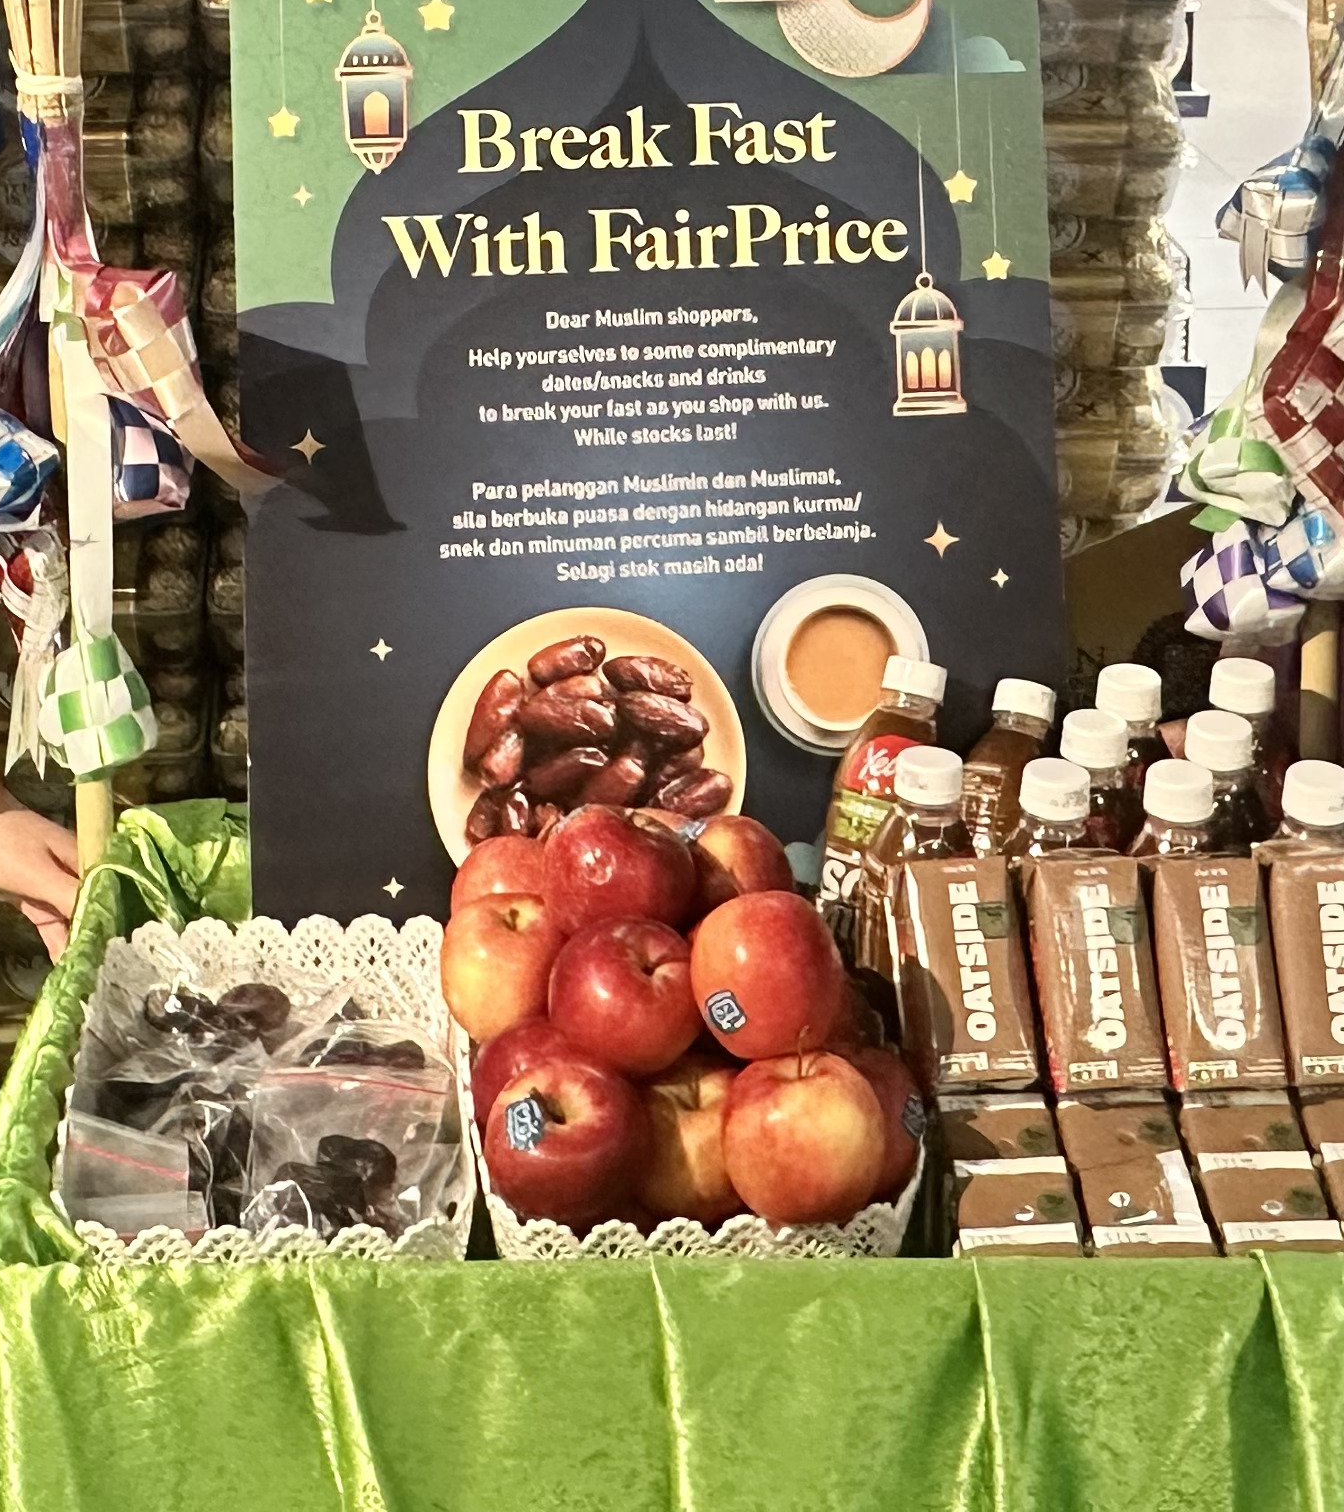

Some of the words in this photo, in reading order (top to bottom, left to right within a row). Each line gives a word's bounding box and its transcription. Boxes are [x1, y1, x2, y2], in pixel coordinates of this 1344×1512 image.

[458, 107, 673, 177] Break
[690, 100, 838, 169] Fast
[382, 210, 569, 281] With
[589, 203, 910, 276] FairPrice
[545, 311, 591, 330] Dear
[595, 308, 663, 328] Muslim
[667, 307, 759, 327] shoppers,
[468, 347, 513, 370] Help
[515, 344, 617, 370] yourselves
[620, 343, 639, 362] to
[642, 344, 693, 362] some
[697, 337, 837, 360] complimentary
[541, 371, 664, 394] dates/snacks
[668, 368, 703, 388] and
[706, 366, 767, 386] drinks
[478, 405, 499, 424] to
[502, 401, 557, 422] break
[560, 401, 603, 425] your
[606, 398, 643, 418] fast
[646, 400, 669, 416] as
[671, 397, 706, 418] you
[709, 394, 755, 416] shop
[757, 391, 798, 412] with
[801, 392, 830, 411] us.
[573, 426, 628, 448] While
[631, 423, 693, 445] stocks
[696, 422, 738, 442] last!
[471, 481, 518, 502] Para
[520, 477, 620, 502] pelanggan
[623, 473, 709, 495] Muslimin
[711, 471, 747, 490] dan
[452, 510, 487, 531] sila
[490, 507, 569, 529] berbuka
[572, 507, 629, 530] puasa
[632, 502, 702, 525] dengan
[704, 497, 790, 521] hidangan
[793, 491, 863, 516] kurma/
[439, 539, 486, 560] snek
[488, 537, 525, 557] dan
[527, 533, 617, 555] minuman
[619, 530, 703, 555] percuma
[706, 525, 769, 547] sambil
[772, 521, 877, 545] berbelanja.
[555, 559, 616, 585] Selagi
[619, 556, 660, 579] stok
[663, 555, 720, 576] masih
[723, 553, 764, 574] ada!
[947, 880, 998, 1042] OATSIDE
[1079, 883, 1127, 1053] OATSIDE
[1199, 884, 1247, 1051] OATSIDE
